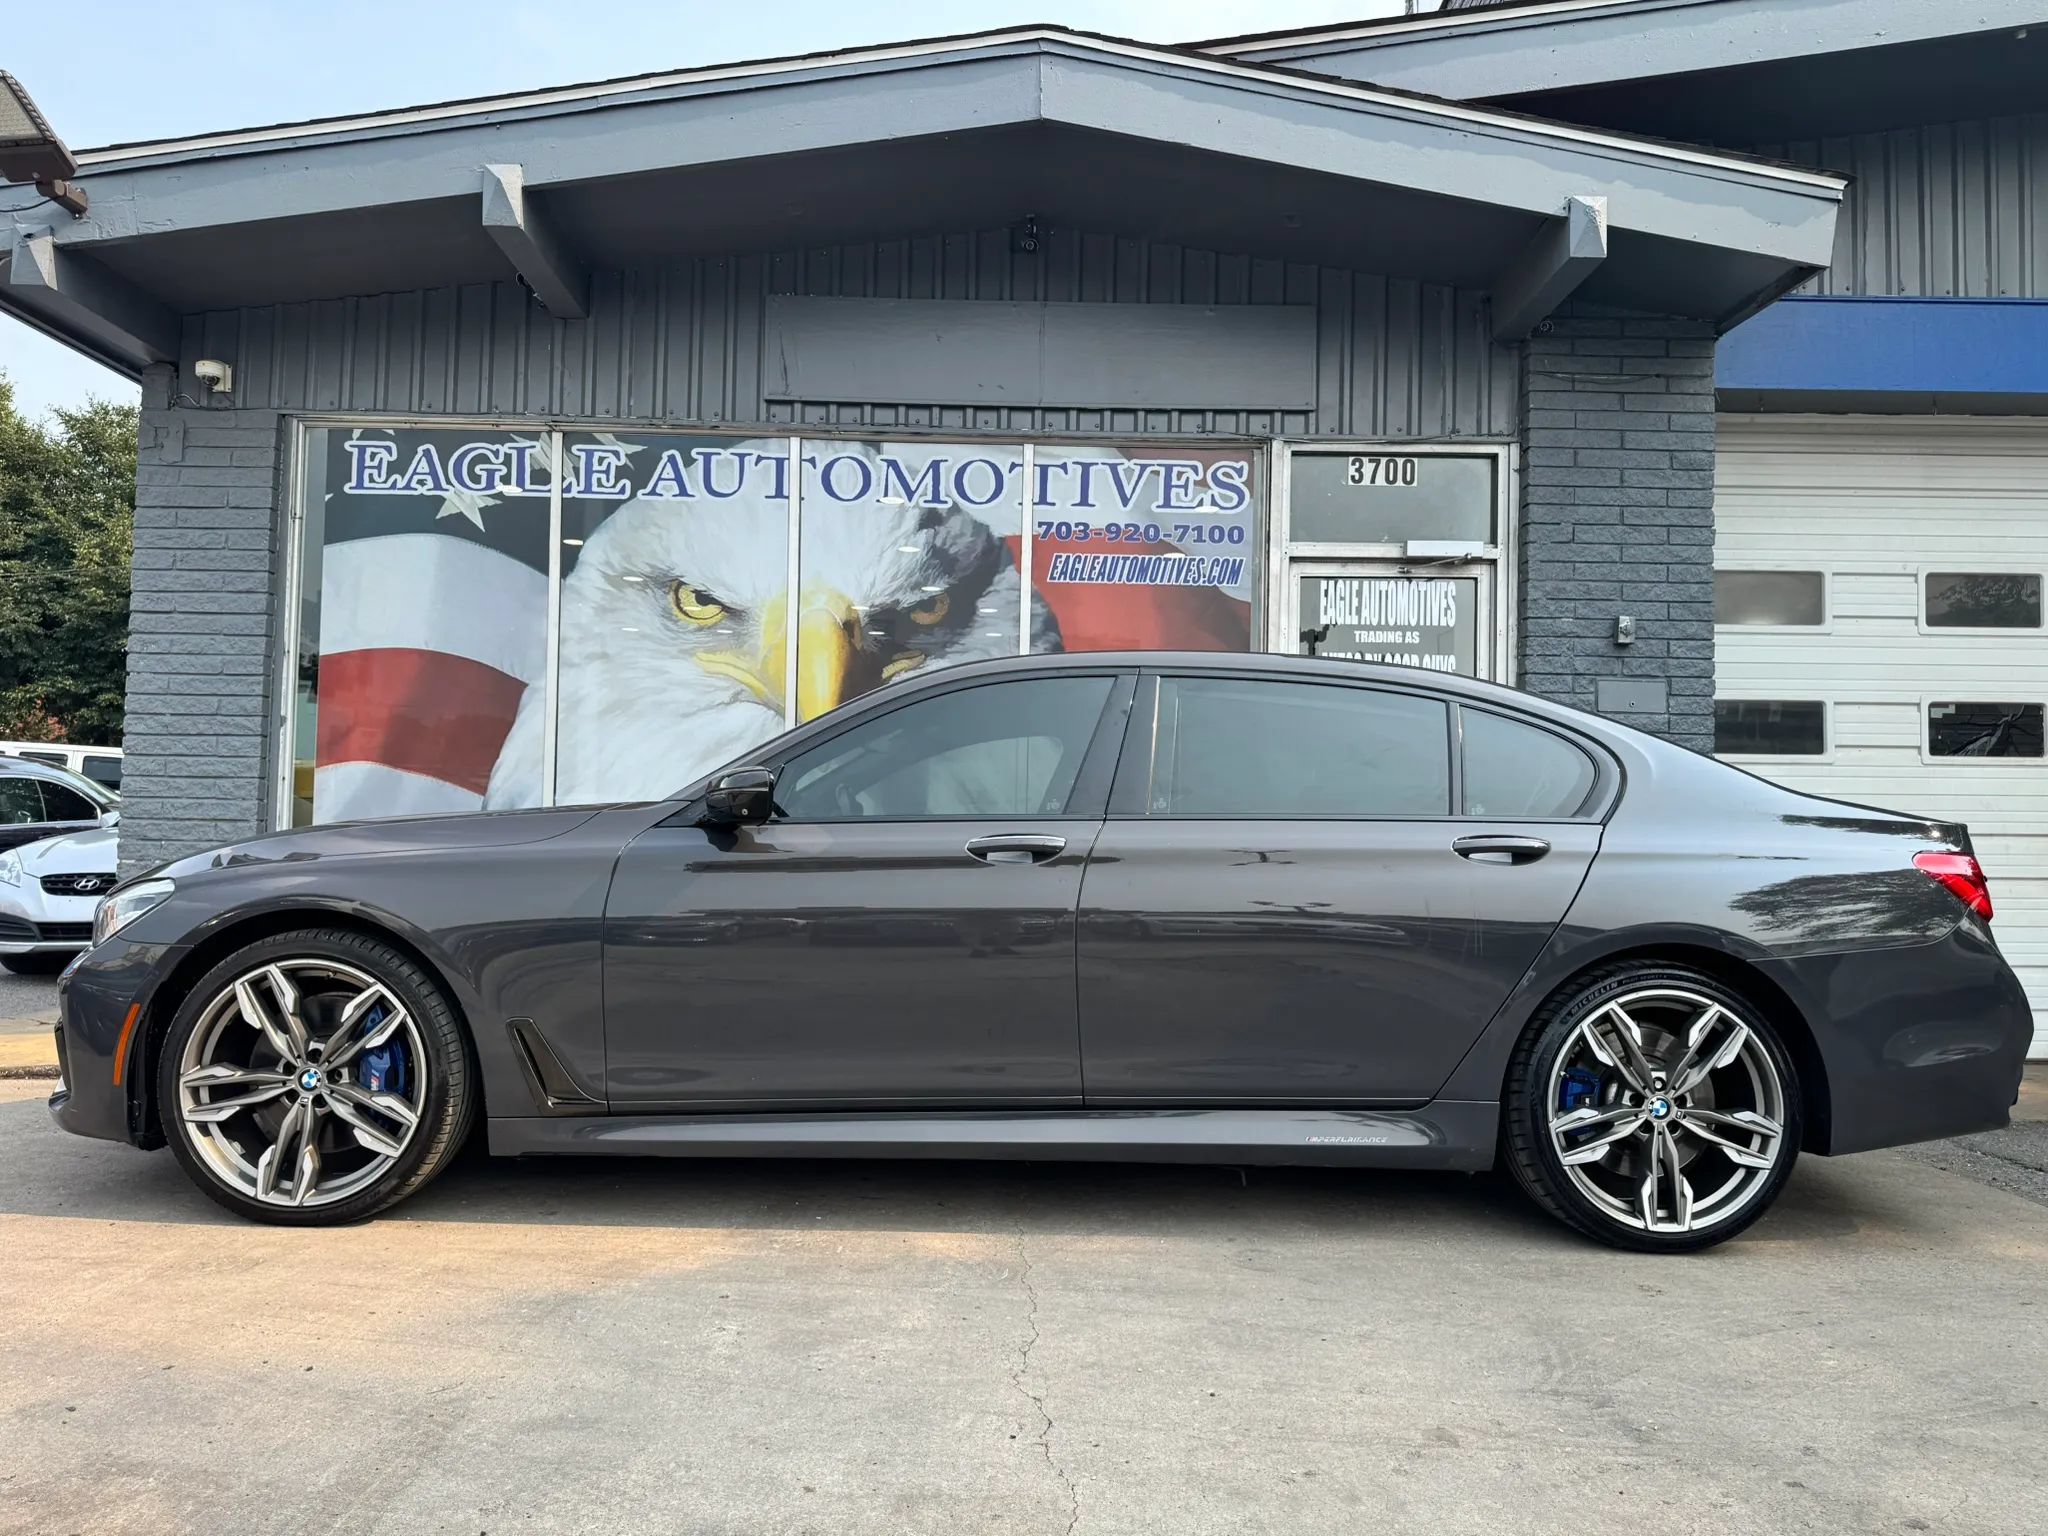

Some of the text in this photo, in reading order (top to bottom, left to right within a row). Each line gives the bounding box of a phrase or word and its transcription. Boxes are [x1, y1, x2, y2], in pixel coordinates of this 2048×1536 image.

[345, 440, 1249, 513] EAGLE AUTOMOTIVES
[1349, 457, 1416, 486] 3700
[1037, 521, 1245, 545] 703-920-7100
[1047, 552, 1245, 587] EAGLEAUTOMOTIVES.COM
[1320, 579, 1457, 627] EAGLE AUTOMOTIVES
[1354, 630, 1420, 644] TRADING AS
